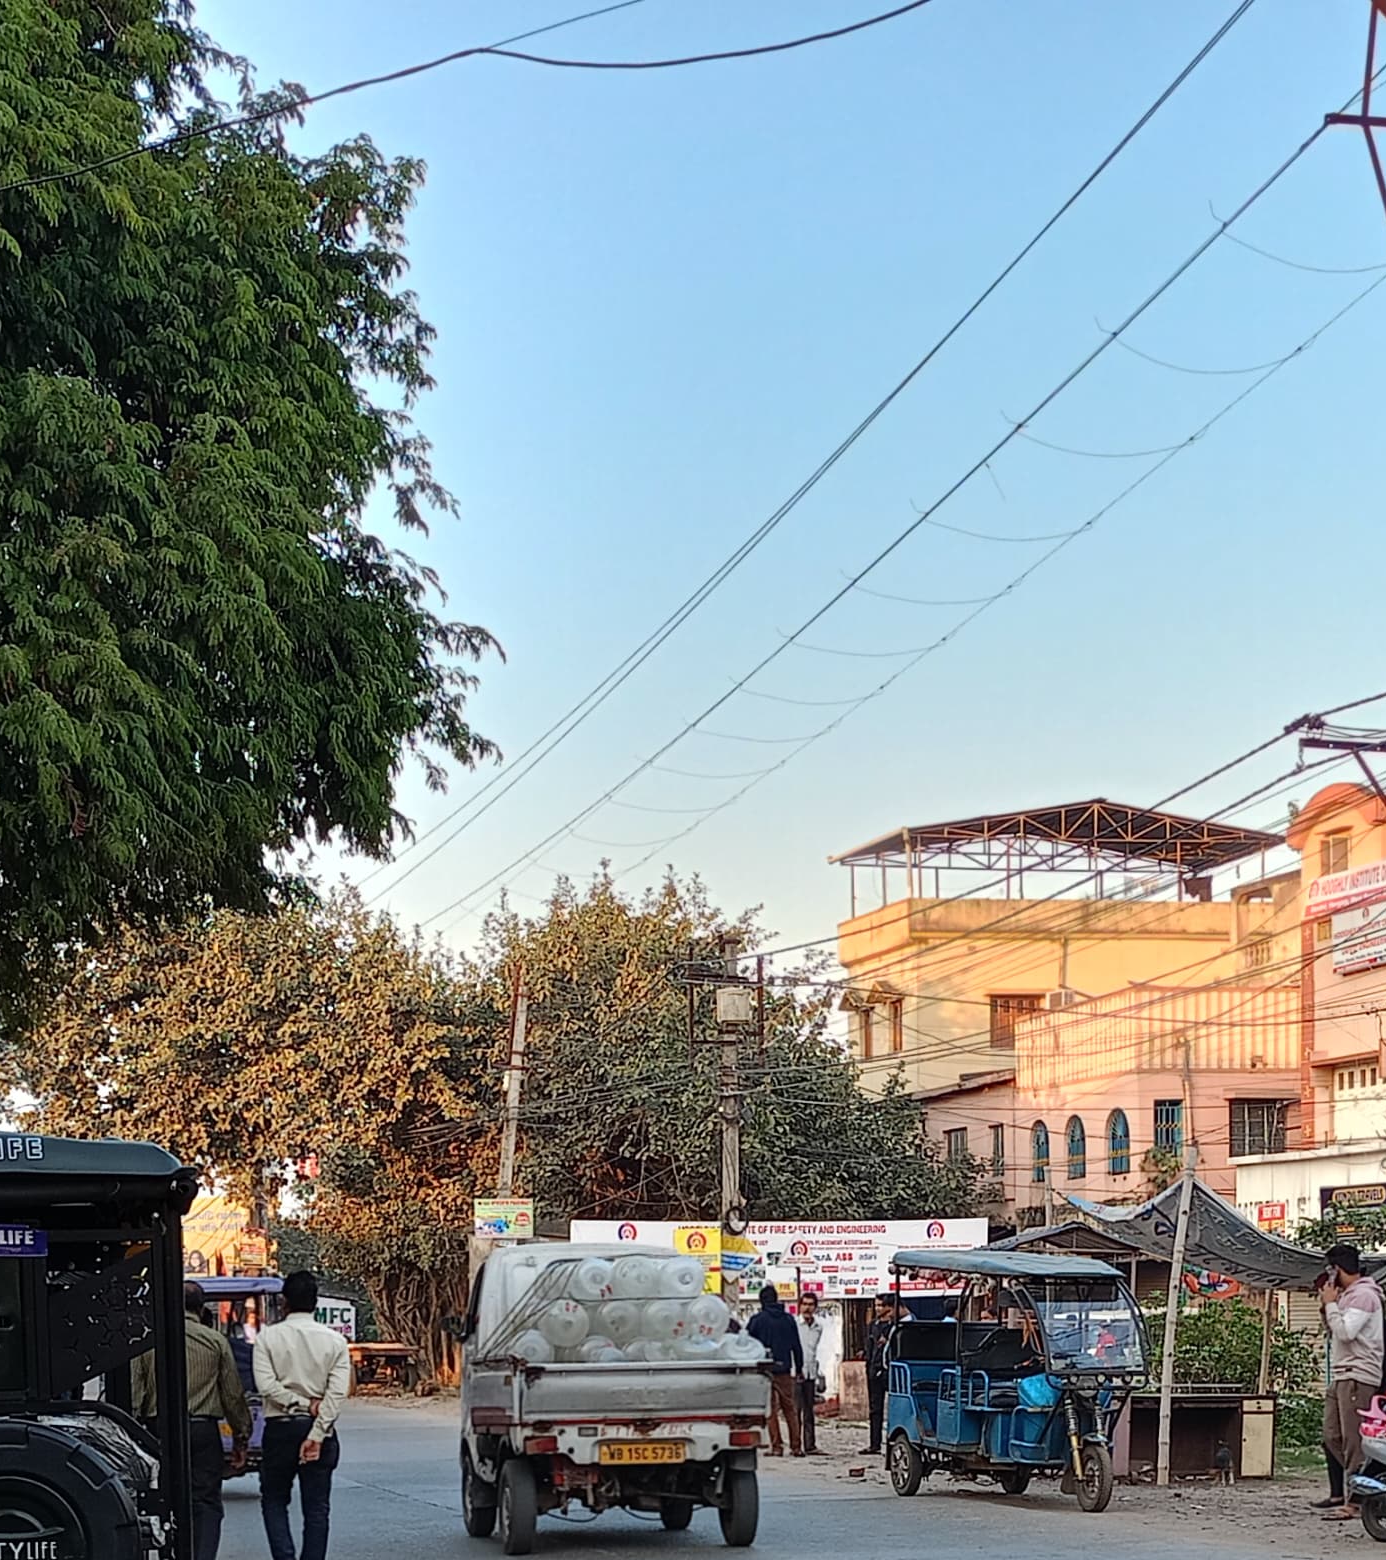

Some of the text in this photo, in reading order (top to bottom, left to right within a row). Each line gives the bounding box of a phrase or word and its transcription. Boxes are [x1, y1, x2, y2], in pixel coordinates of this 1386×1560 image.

[758, 1225, 767, 1234] OF
[770, 1224, 786, 1234] FIRE
[819, 1225, 835, 1234] AND
[836, 1224, 887, 1234] ENGINEERING
[0, 1229, 34, 1245] LIFE
[314, 1306, 351, 1324] MFC
[608, 1446, 683, 1461] WB 15C 5736
